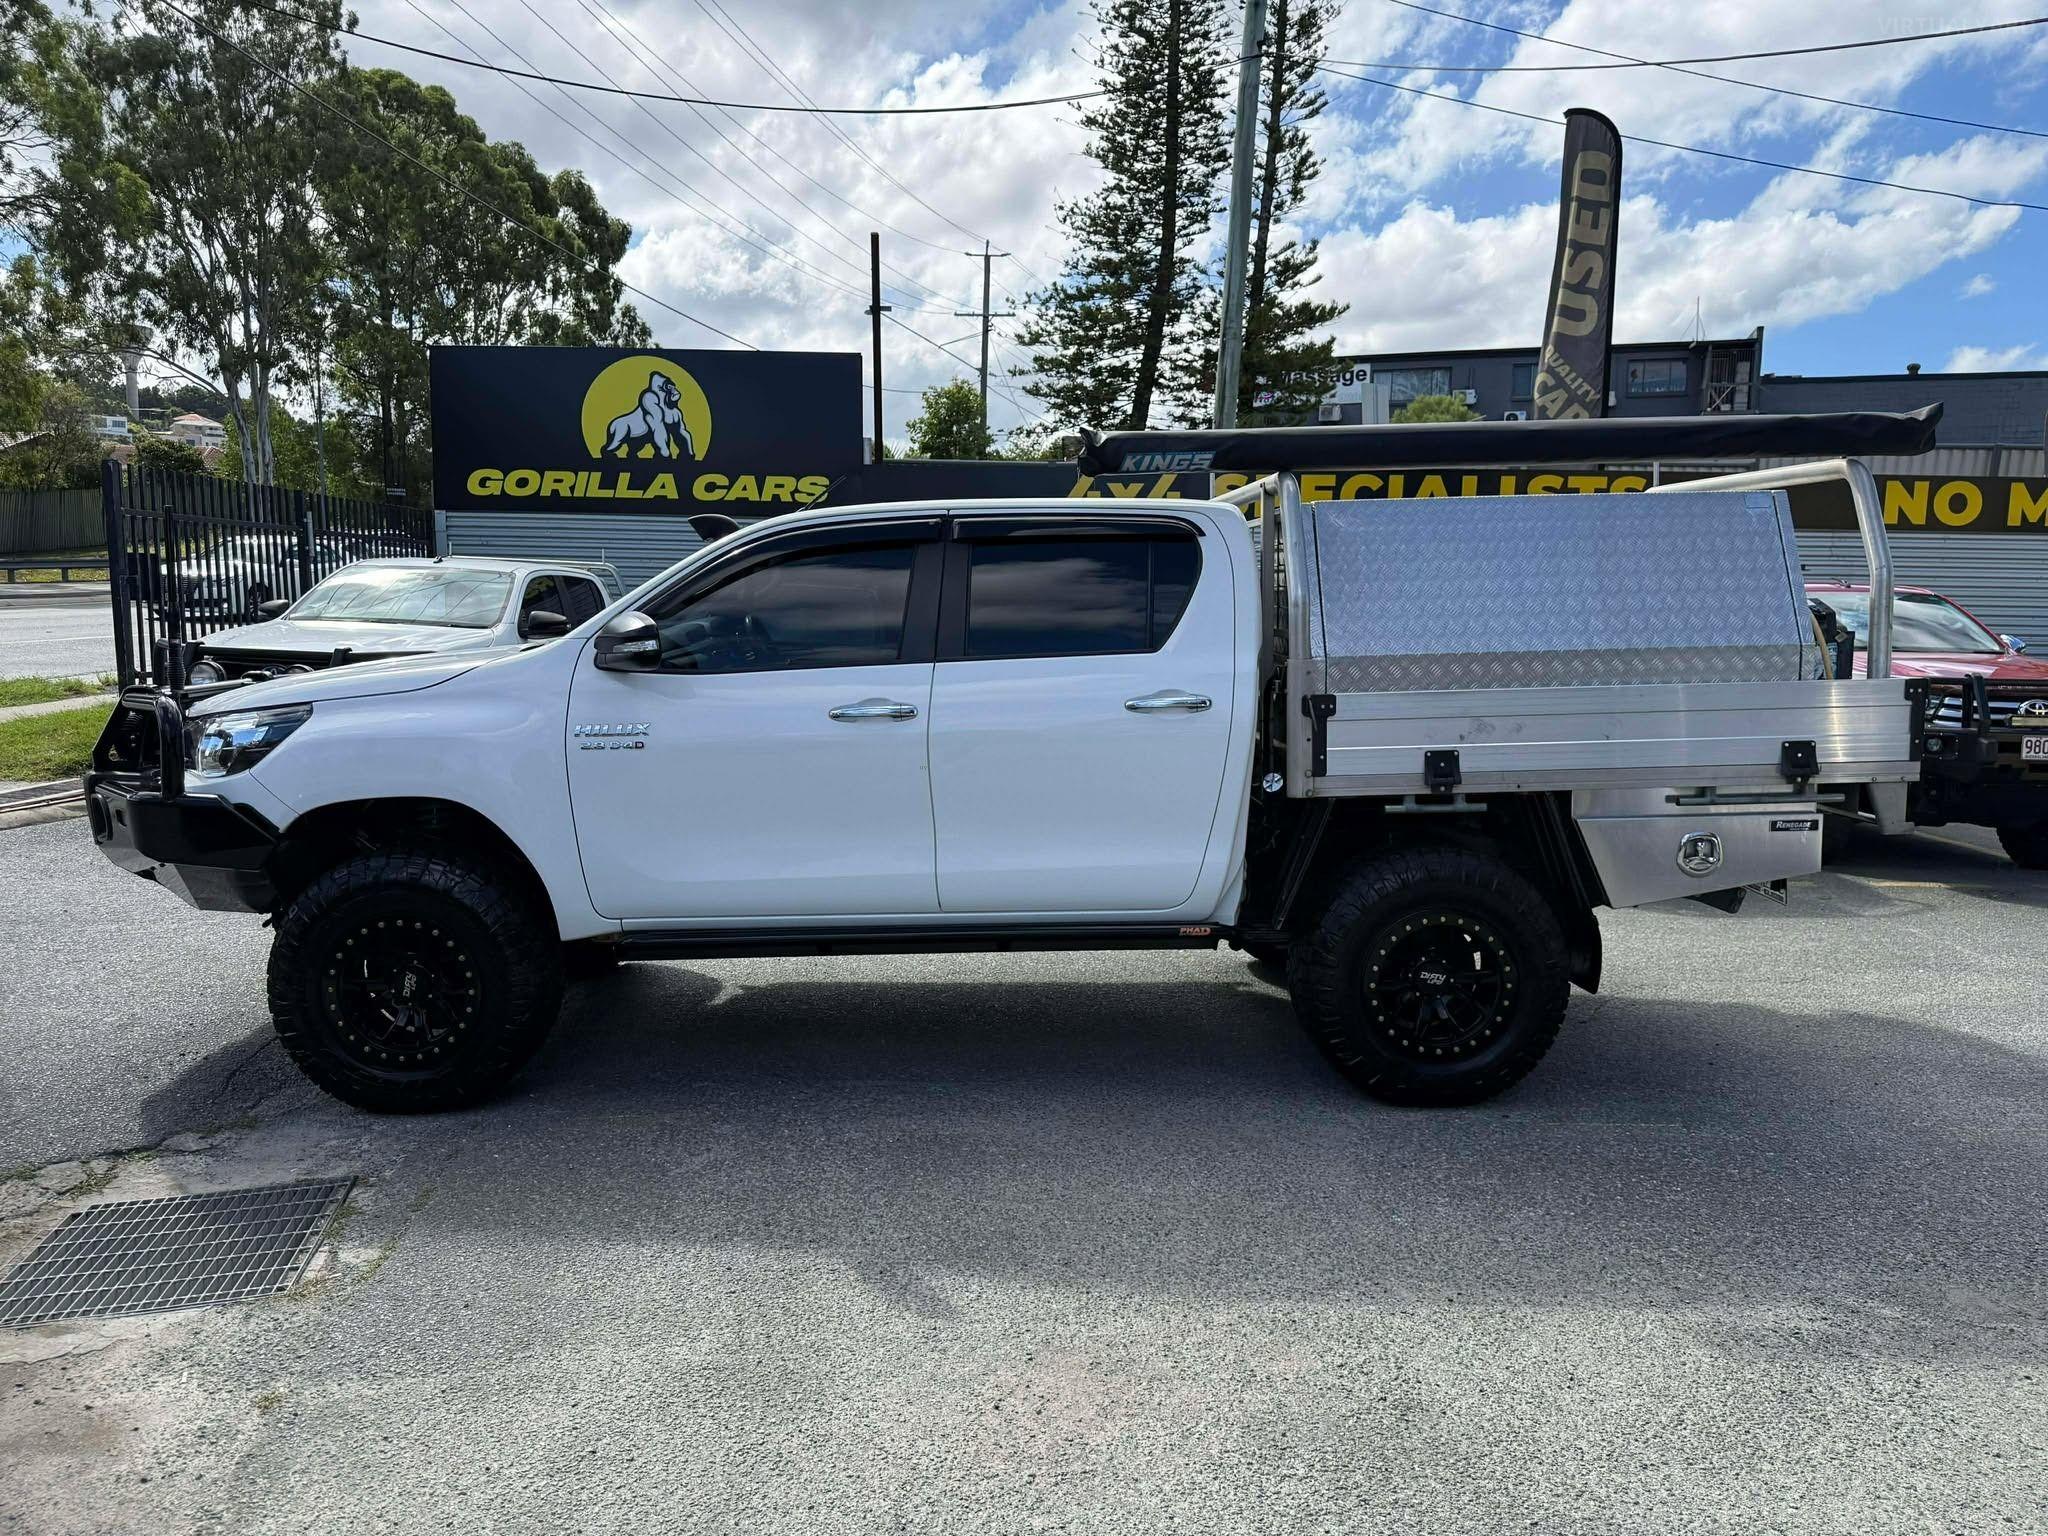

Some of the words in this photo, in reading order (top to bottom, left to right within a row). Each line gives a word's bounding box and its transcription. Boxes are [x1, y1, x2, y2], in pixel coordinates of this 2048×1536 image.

[1552, 150, 1612, 337] USED
[1544, 344, 1601, 403] QUALITY
[1120, 453, 1215, 472] KINGS
[466, 468, 679, 500] GORILLA
[692, 473, 831, 503] CARS
[1884, 480, 1983, 527] NO
[574, 722, 651, 738] HILUX
[1776, 820, 1812, 829] RENEGADE
